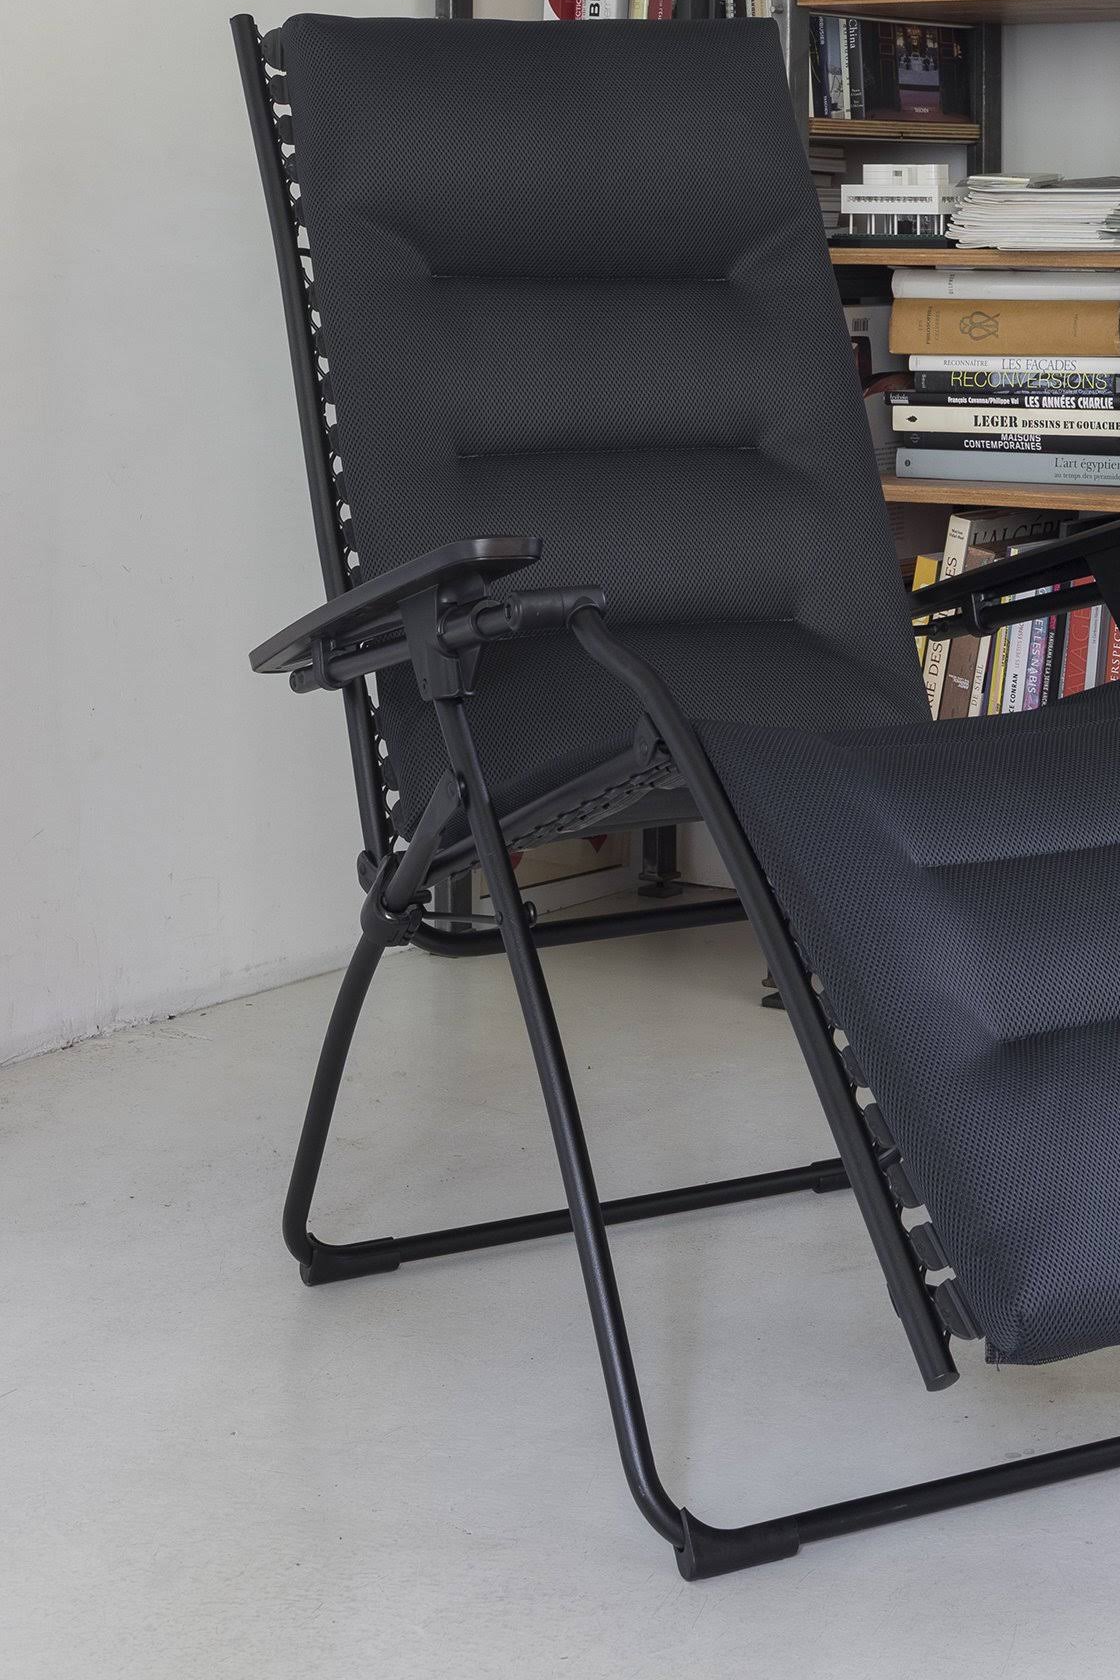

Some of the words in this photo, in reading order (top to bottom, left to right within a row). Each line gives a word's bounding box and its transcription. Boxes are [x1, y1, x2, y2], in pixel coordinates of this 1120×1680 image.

[1001, 358, 1021, 370] LES
[1025, 358, 1077, 372] FAÇADES
[951, 372, 1108, 390] RECONVERSIONS
[1024, 396, 1040, 407] LES
[1042, 394, 1076, 408] ANNÉES
[1078, 397, 1114, 409] CHARLIE
[973, 415, 1018, 428] LEGER
[1022, 418, 1061, 429] DESSINS
[1063, 420, 1074, 429] ET
[964, 439, 1042, 450] CONTEMPORAINES
[1001, 433, 1041, 442] MAISONS
[1054, 457, 1078, 469] L'art
[1010, 673, 1018, 703] CONRAN
